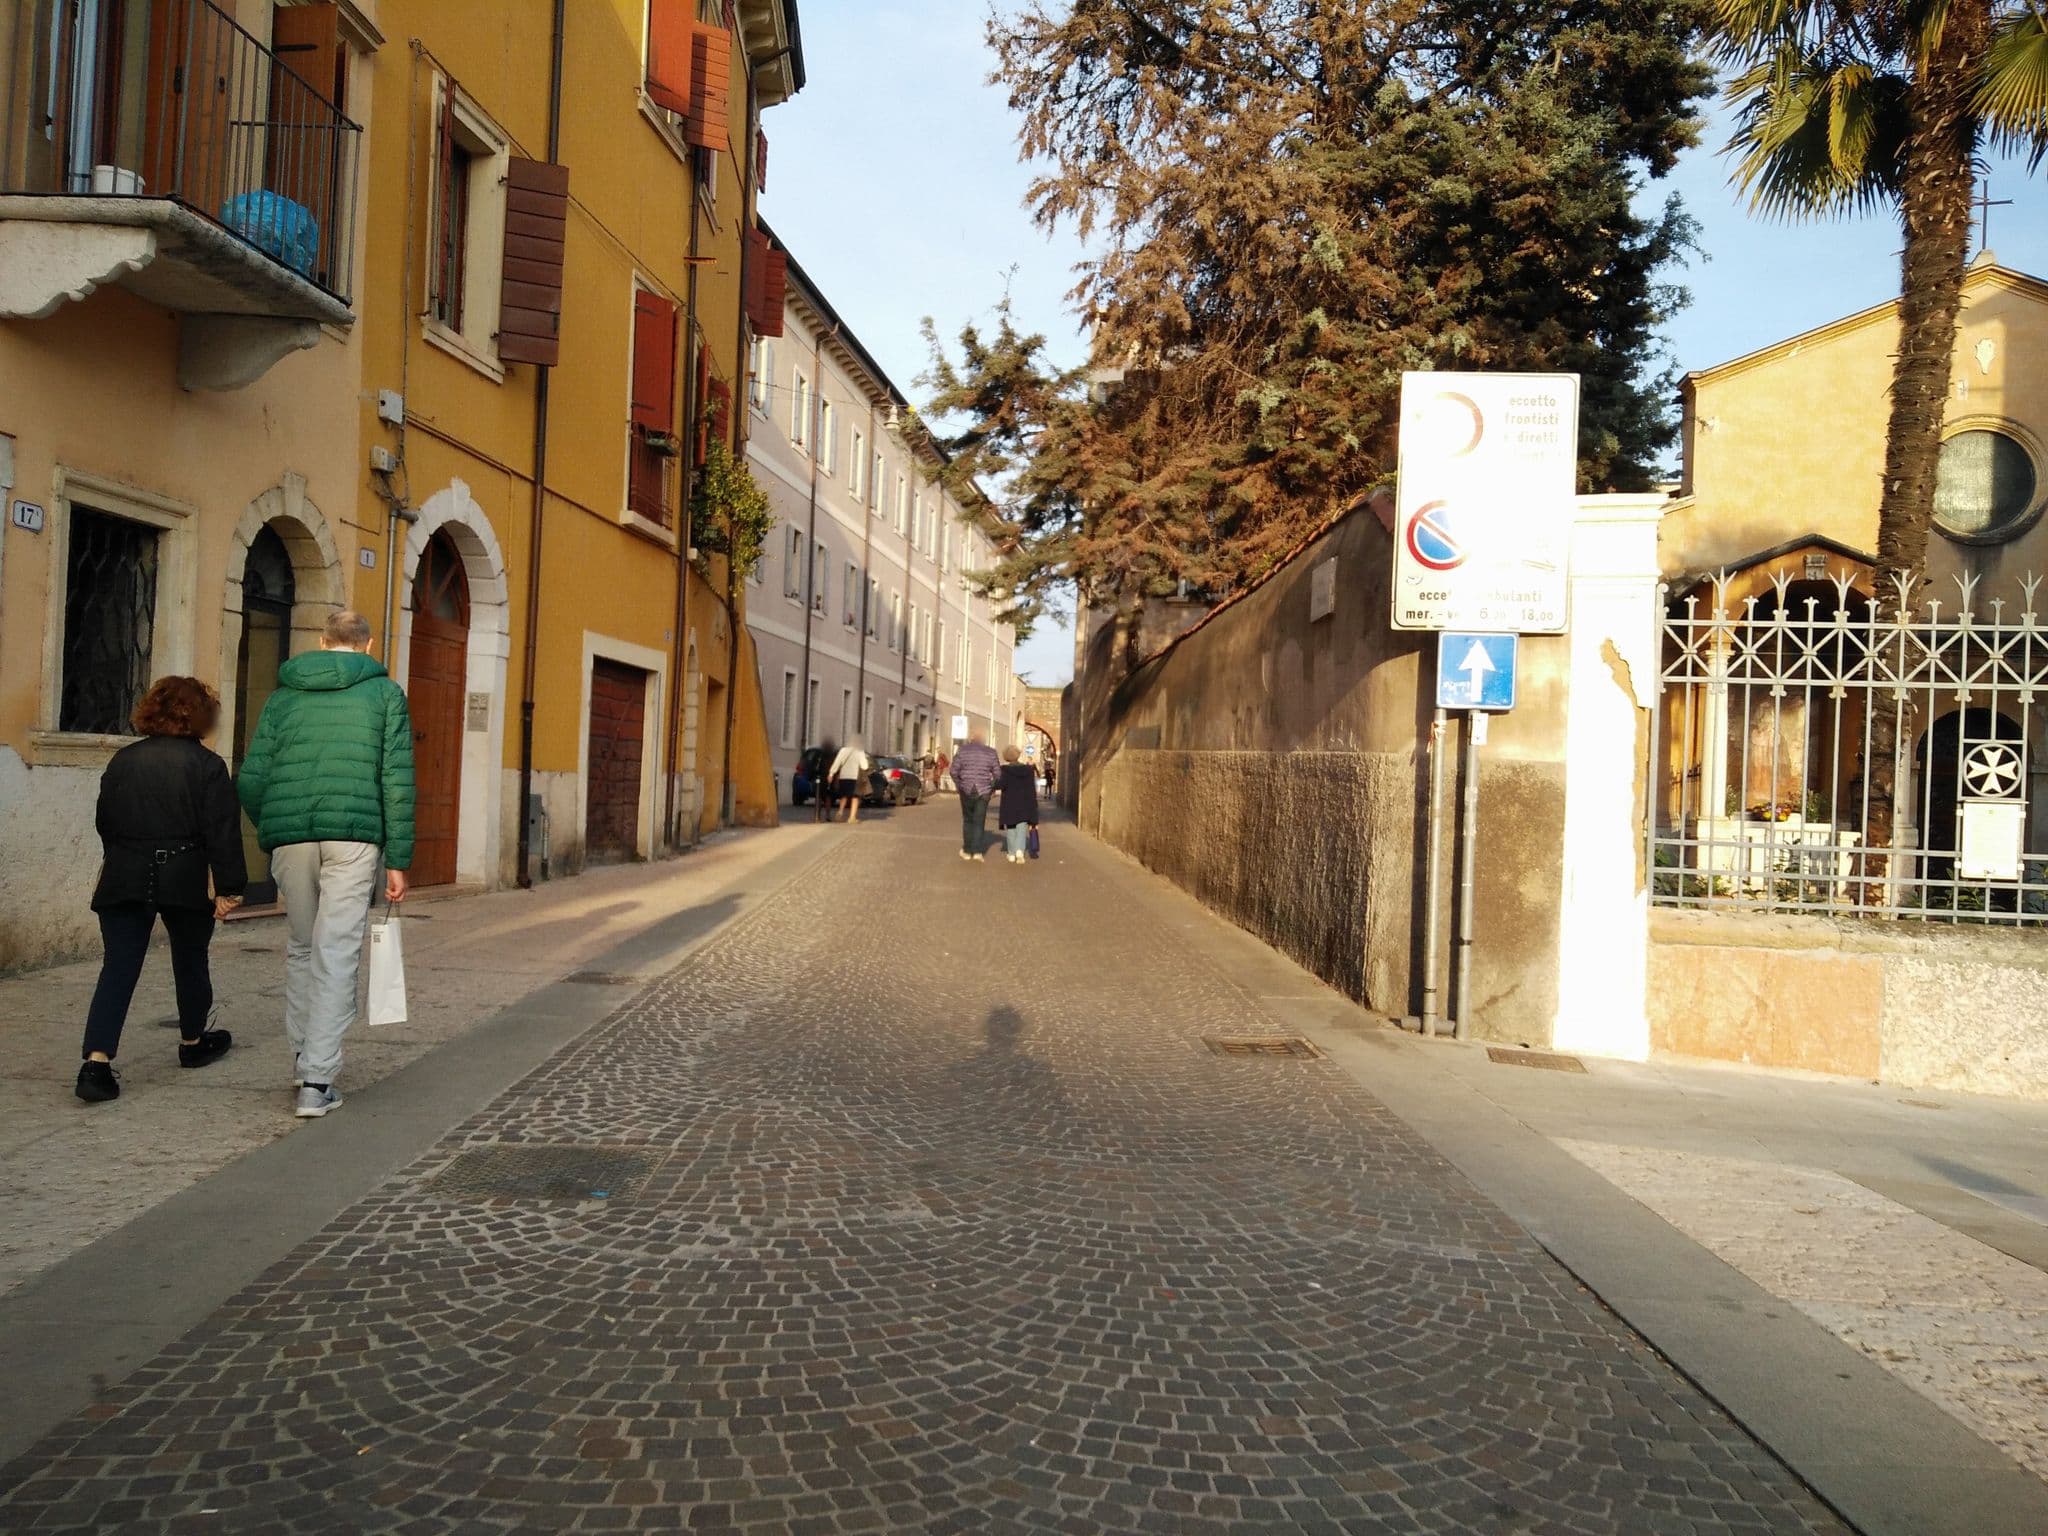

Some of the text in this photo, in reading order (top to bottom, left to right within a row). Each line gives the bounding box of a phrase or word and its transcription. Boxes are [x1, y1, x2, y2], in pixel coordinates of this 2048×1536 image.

[1509, 394, 1557, 407] eccetto
[1504, 411, 1559, 425] frontisti
[1405, 610, 1434, 620] mer.
